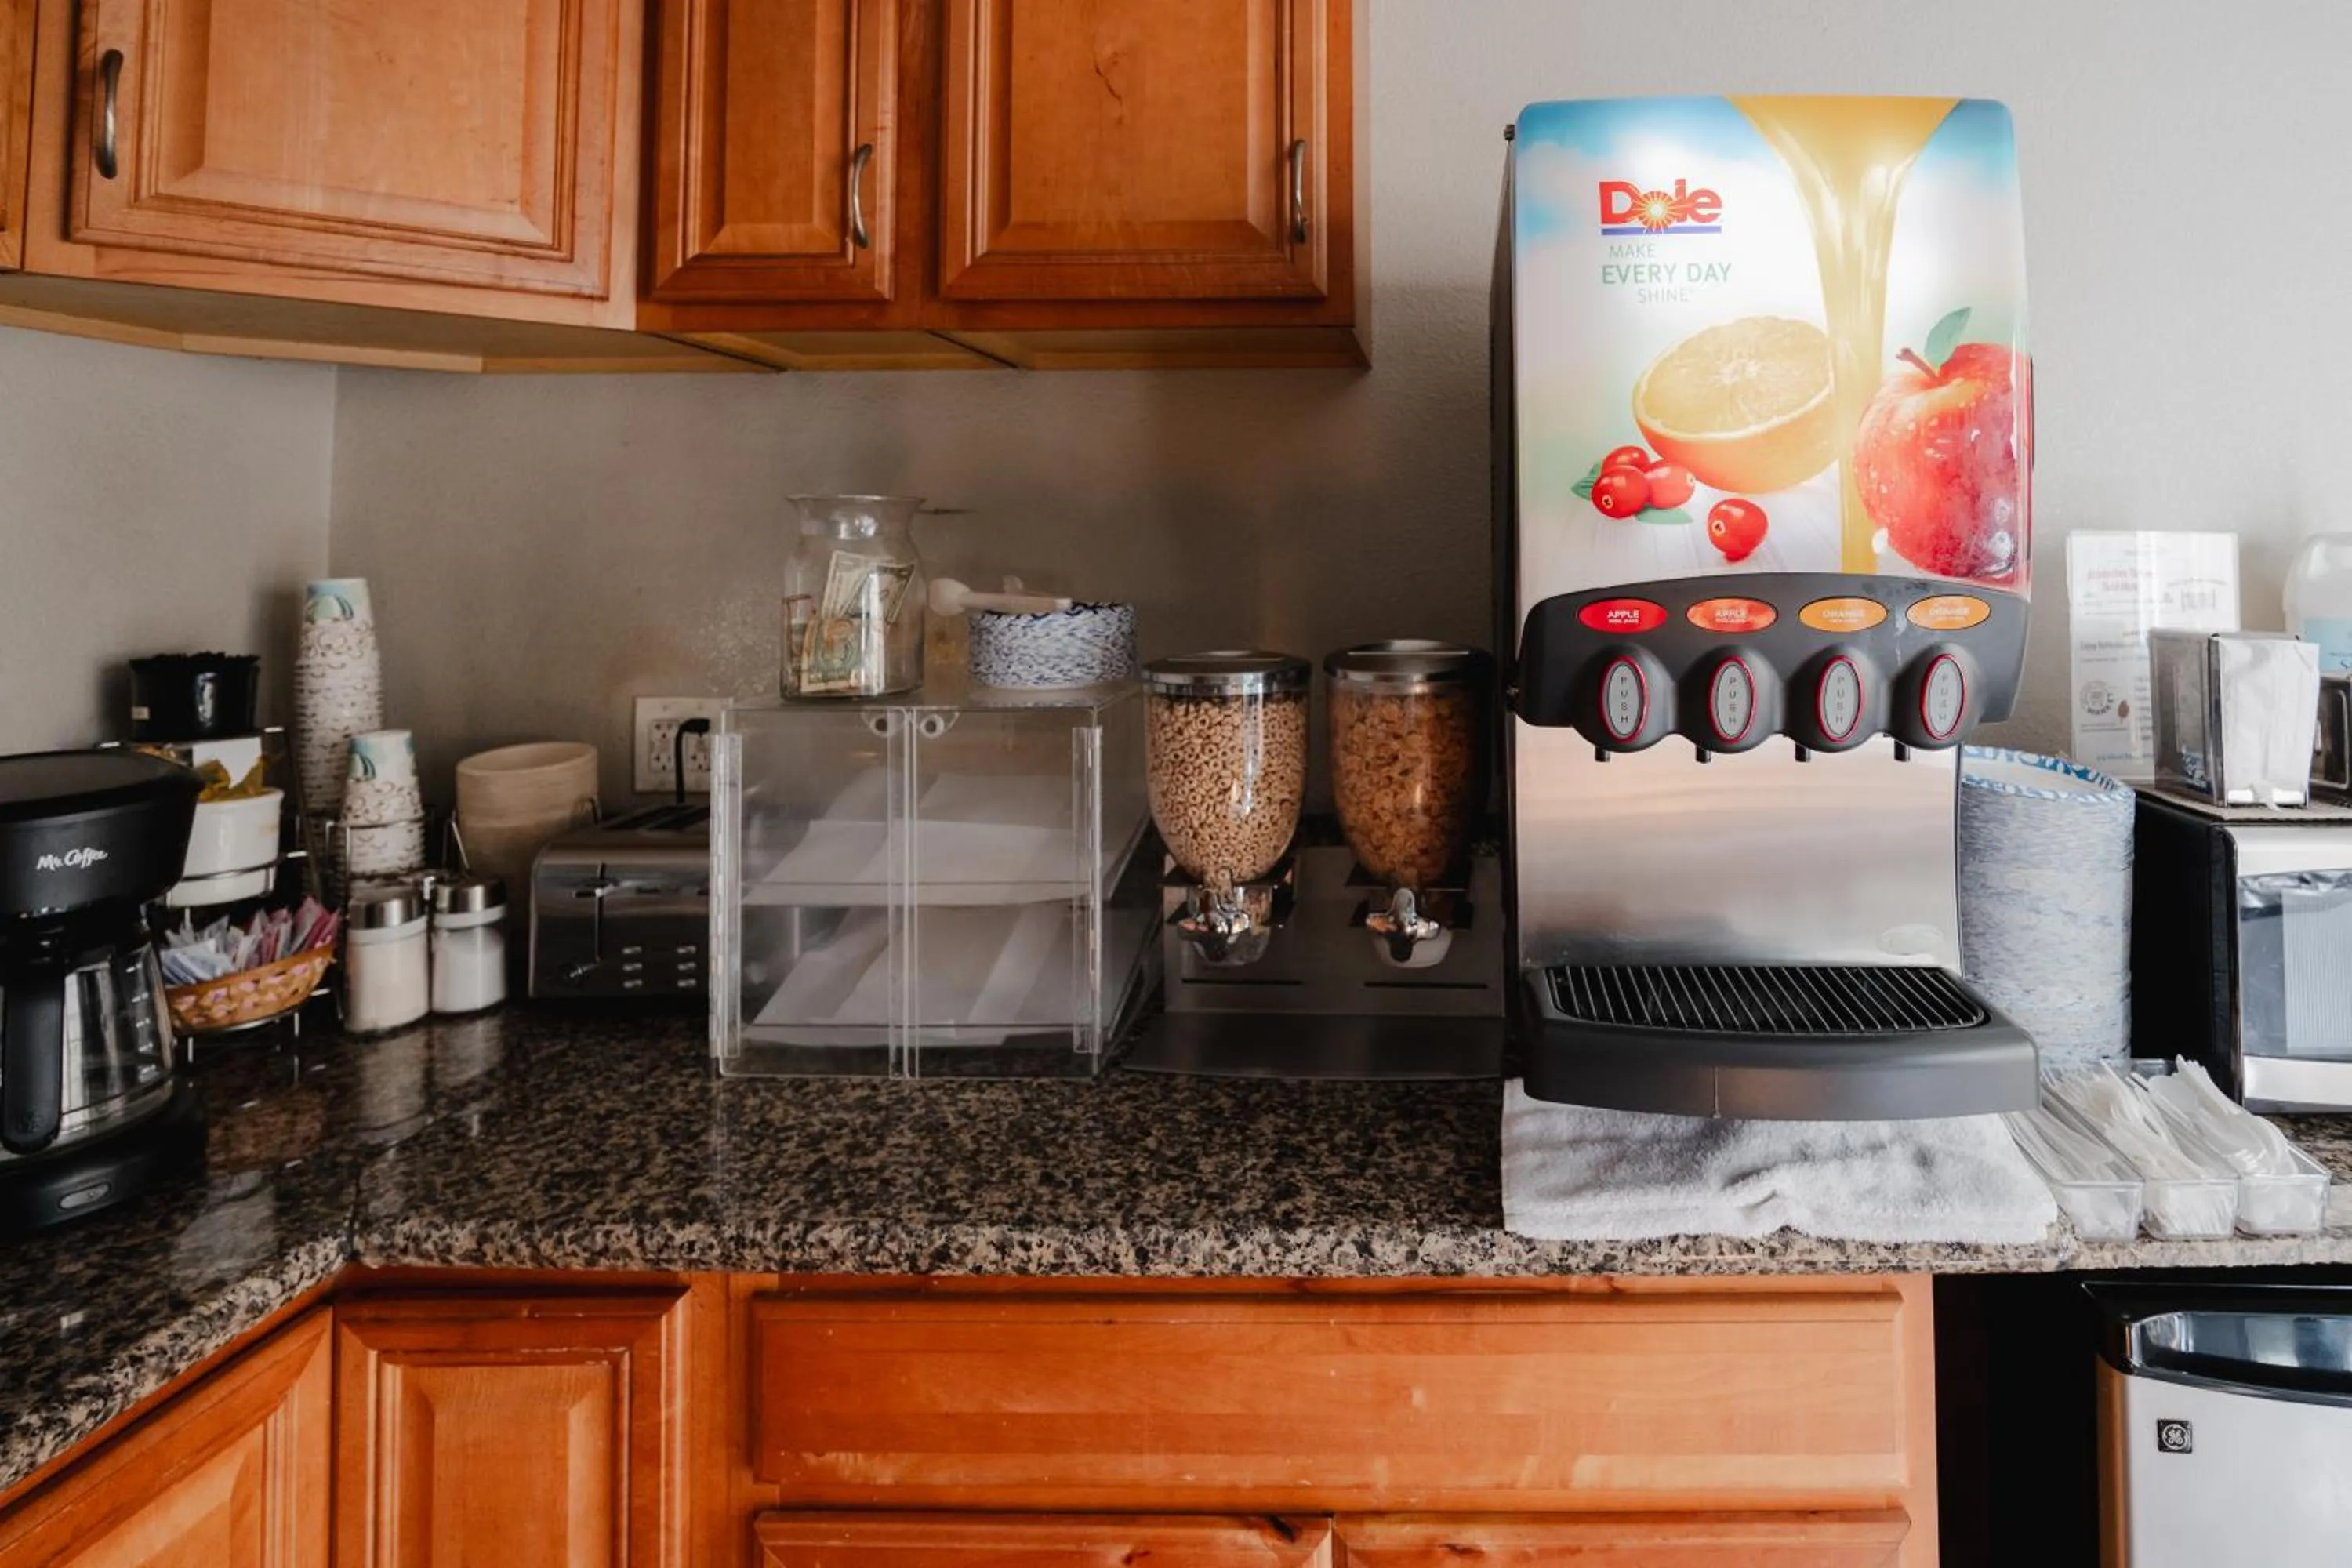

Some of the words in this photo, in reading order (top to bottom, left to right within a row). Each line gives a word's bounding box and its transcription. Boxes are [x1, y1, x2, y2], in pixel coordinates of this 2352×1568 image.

[1599, 178, 1722, 230] Dole
[1608, 243, 1657, 259] MAKE
[1602, 263, 1678, 285] EVERY
[1686, 262, 1732, 283] DAY
[1637, 287, 1690, 304] SHINE
[1606, 609, 1639, 619] APPLE
[1714, 608, 1748, 619] APPLE
[1620, 676, 1629, 724] PUSH
[1727, 676, 1737, 725] PUSH
[1835, 675, 1846, 725] PUSH
[64, 846, 109, 869] Coffee
